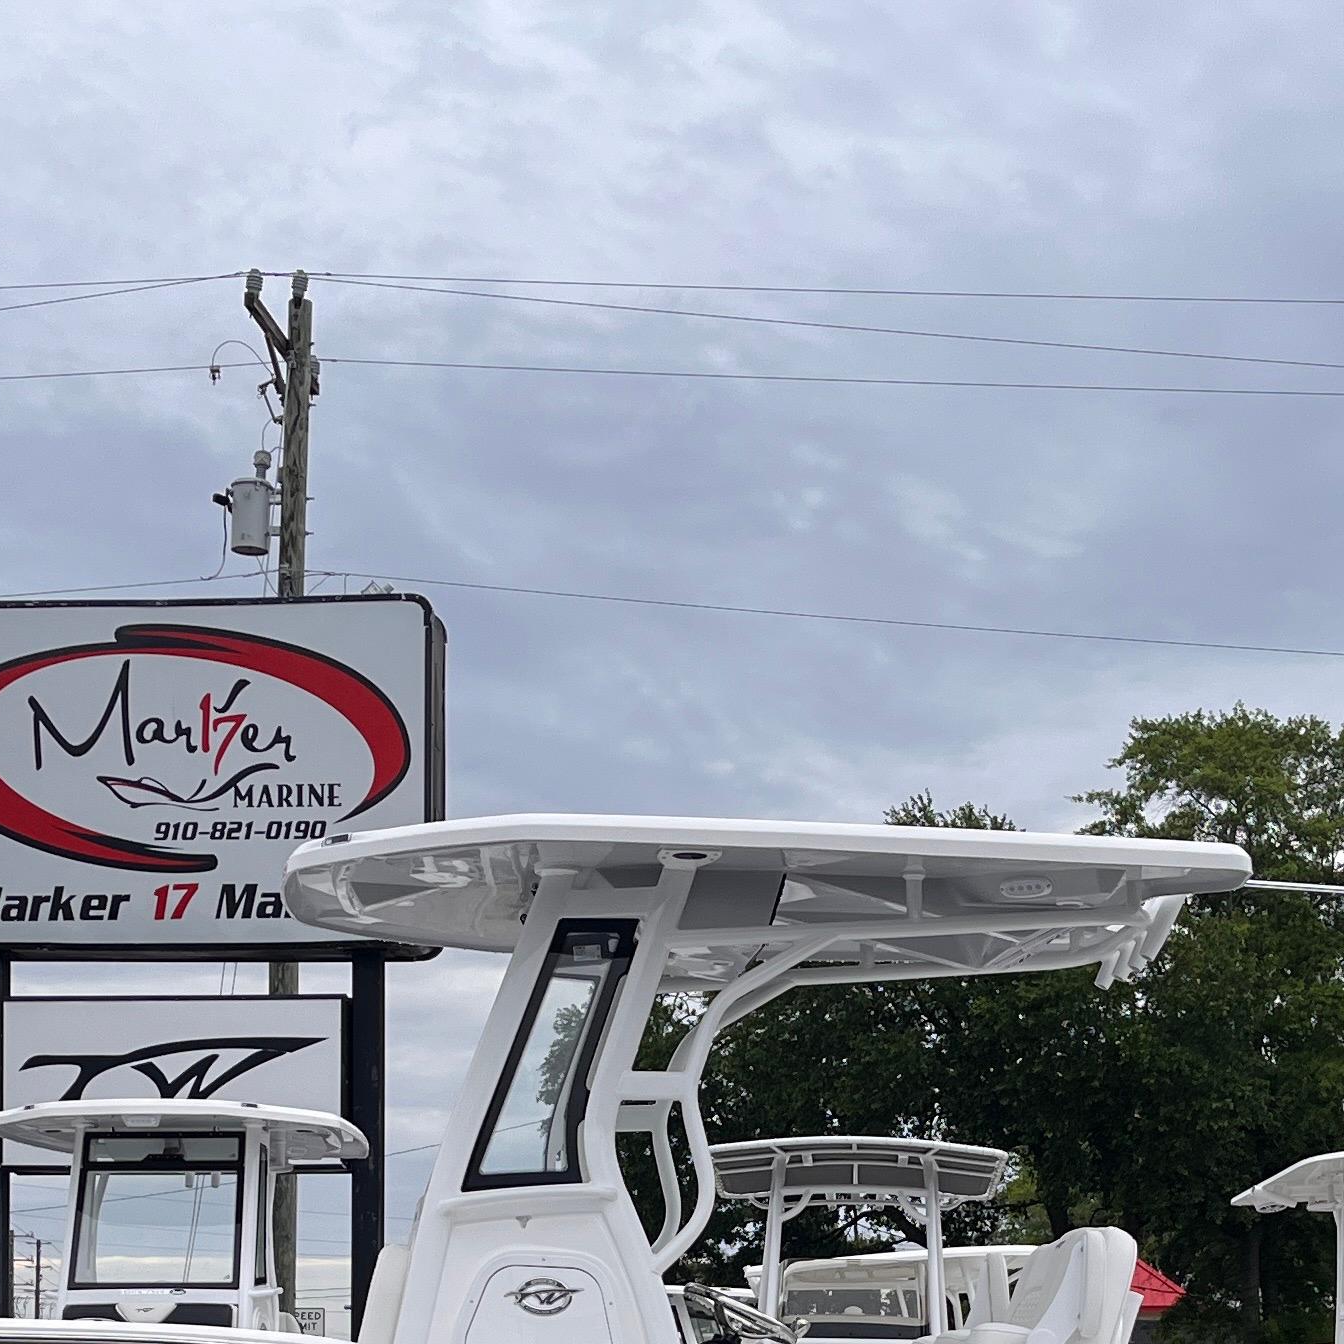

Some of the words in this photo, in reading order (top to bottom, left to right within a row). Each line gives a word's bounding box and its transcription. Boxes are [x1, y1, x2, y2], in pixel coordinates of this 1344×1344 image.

[232, 783, 342, 808] MARINE
[154, 820, 327, 841] 910-821-0190
[153, 883, 199, 920] 17
[295, 1311, 322, 1321] PEED
